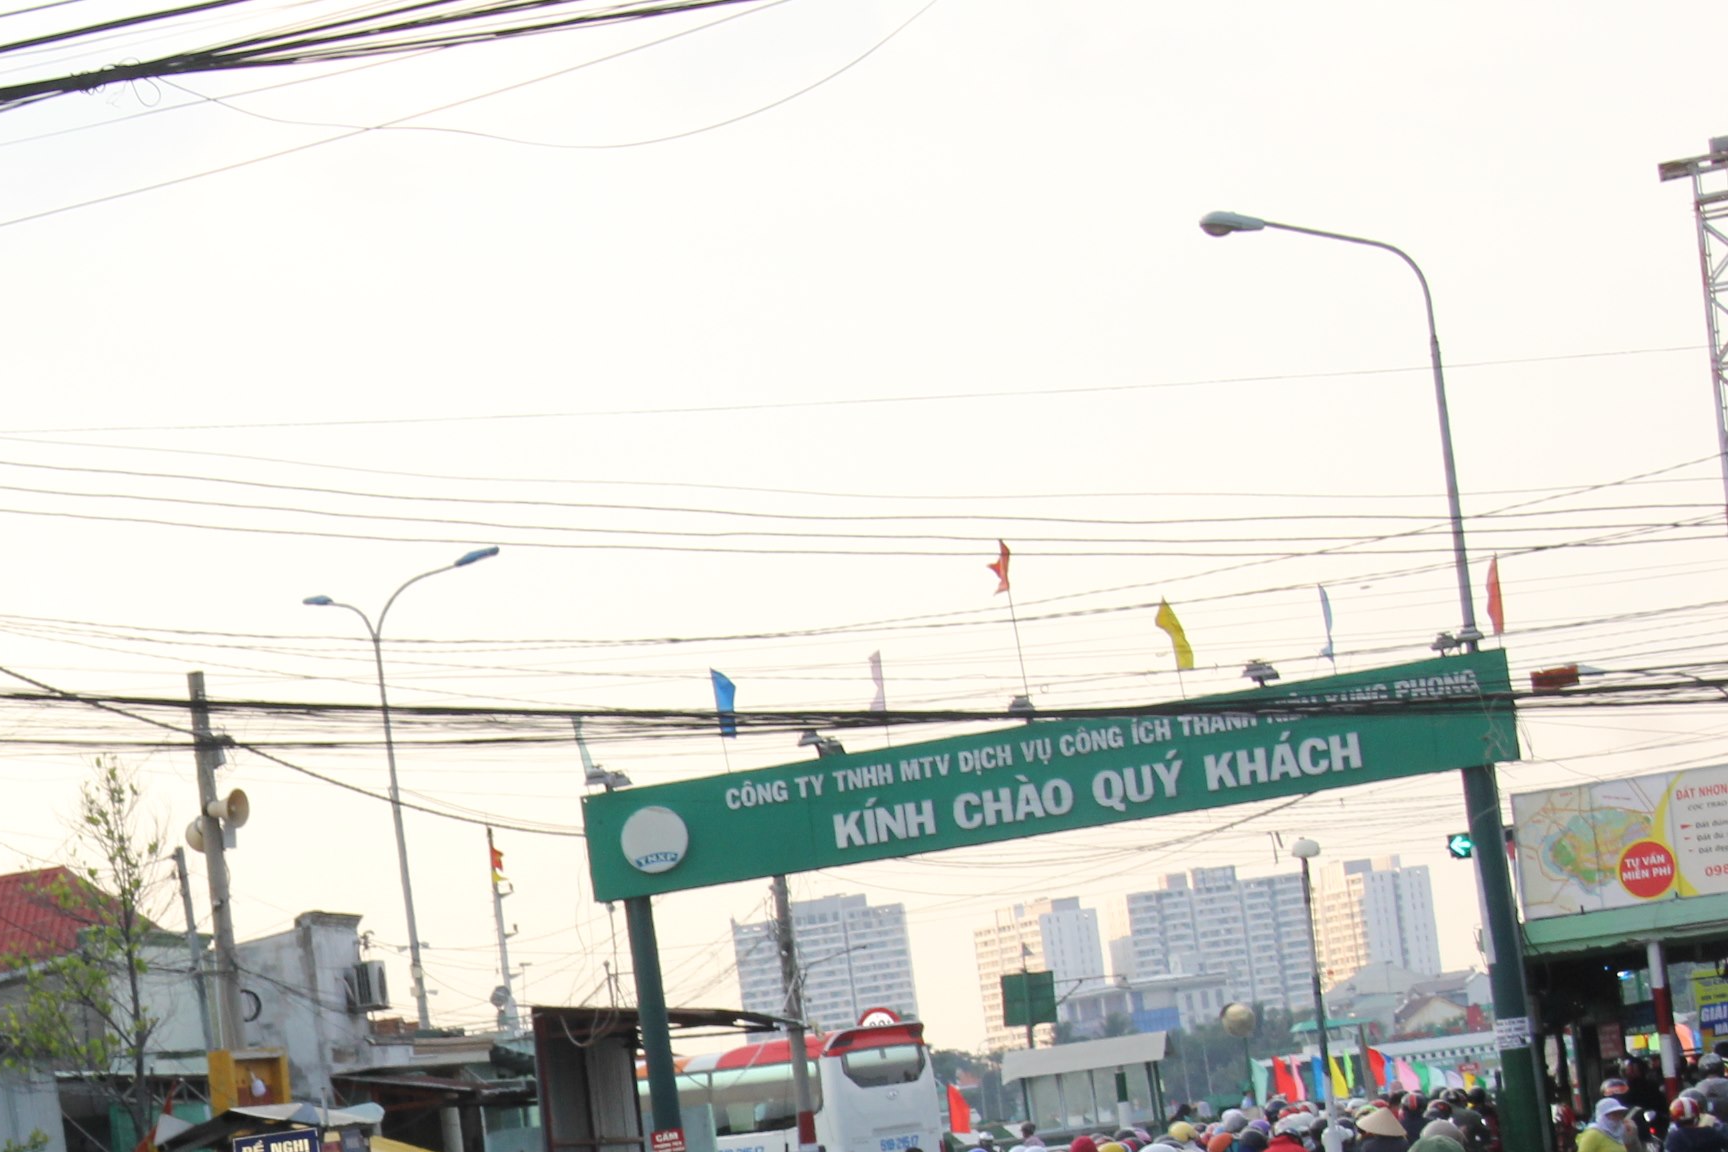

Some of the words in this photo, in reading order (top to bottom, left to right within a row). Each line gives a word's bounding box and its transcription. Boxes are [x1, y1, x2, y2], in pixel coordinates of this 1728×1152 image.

[725, 780, 789, 810] CÔNG
[794, 774, 825, 798] TY
[832, 763, 894, 793] TNHH
[899, 753, 950, 781] MTV
[958, 744, 1013, 775] DỊCH
[1020, 737, 1052, 765] VỤ
[1059, 726, 1125, 757] CÔNG
[1131, 717, 1172, 745] ÍCH
[832, 797, 937, 850] KÍNH
[953, 774, 1074, 830] CHÀO
[1092, 749, 1184, 812] QUÝ
[1203, 731, 1363, 792] KHÁCH
